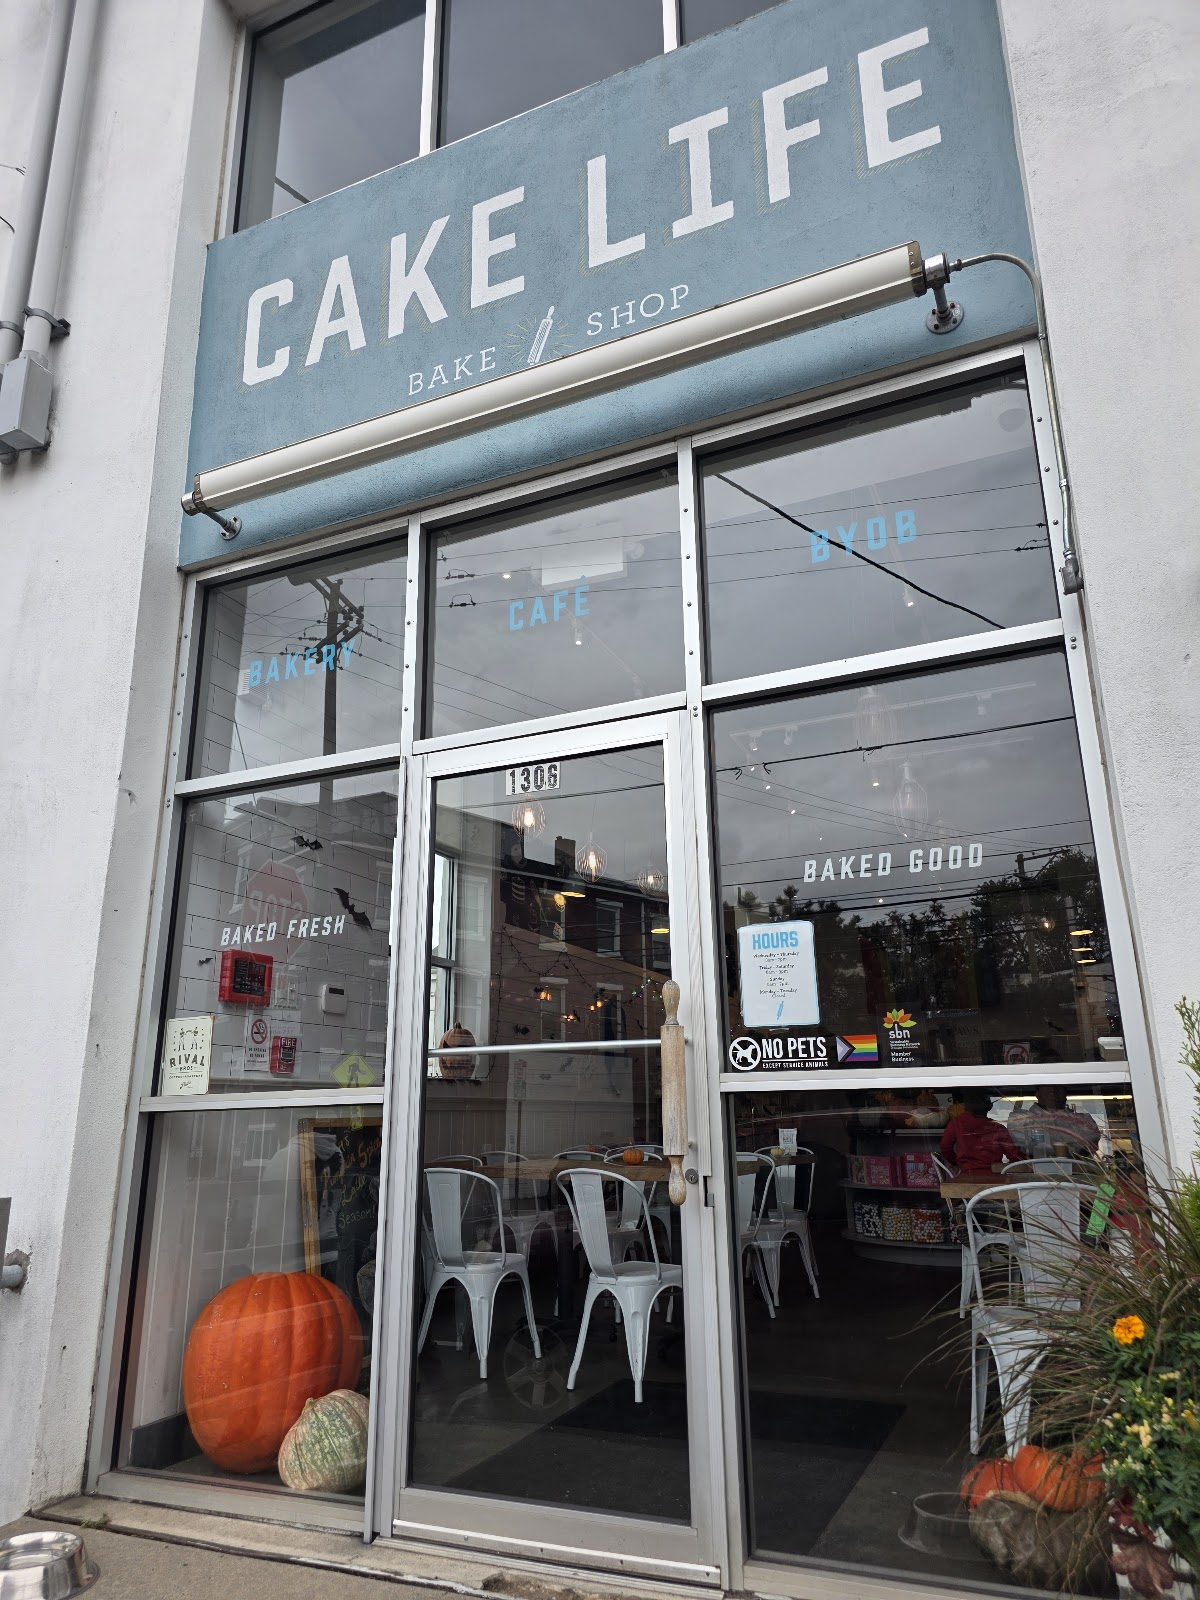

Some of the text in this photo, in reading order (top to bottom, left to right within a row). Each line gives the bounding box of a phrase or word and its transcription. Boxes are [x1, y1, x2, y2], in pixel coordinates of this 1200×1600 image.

[241, 27, 942, 386] CAKE LIFE
[407, 284, 691, 397] BAKE SHOP
[809, 508, 918, 565] BYOB
[509, 575, 590, 631] CAFÉ
[248, 640, 355, 687] BAKERY
[509, 764, 558, 794] 1306
[803, 843, 983, 883] BAKED GOOD
[220, 915, 345, 946] BAKED FRESH
[752, 930, 799, 950] HOURS
[281, 1038, 296, 1047] FIRE
[889, 1023, 911, 1039] sbn
[169, 1054, 205, 1068] RIVAL
[761, 1036, 827, 1059] NO PETS
